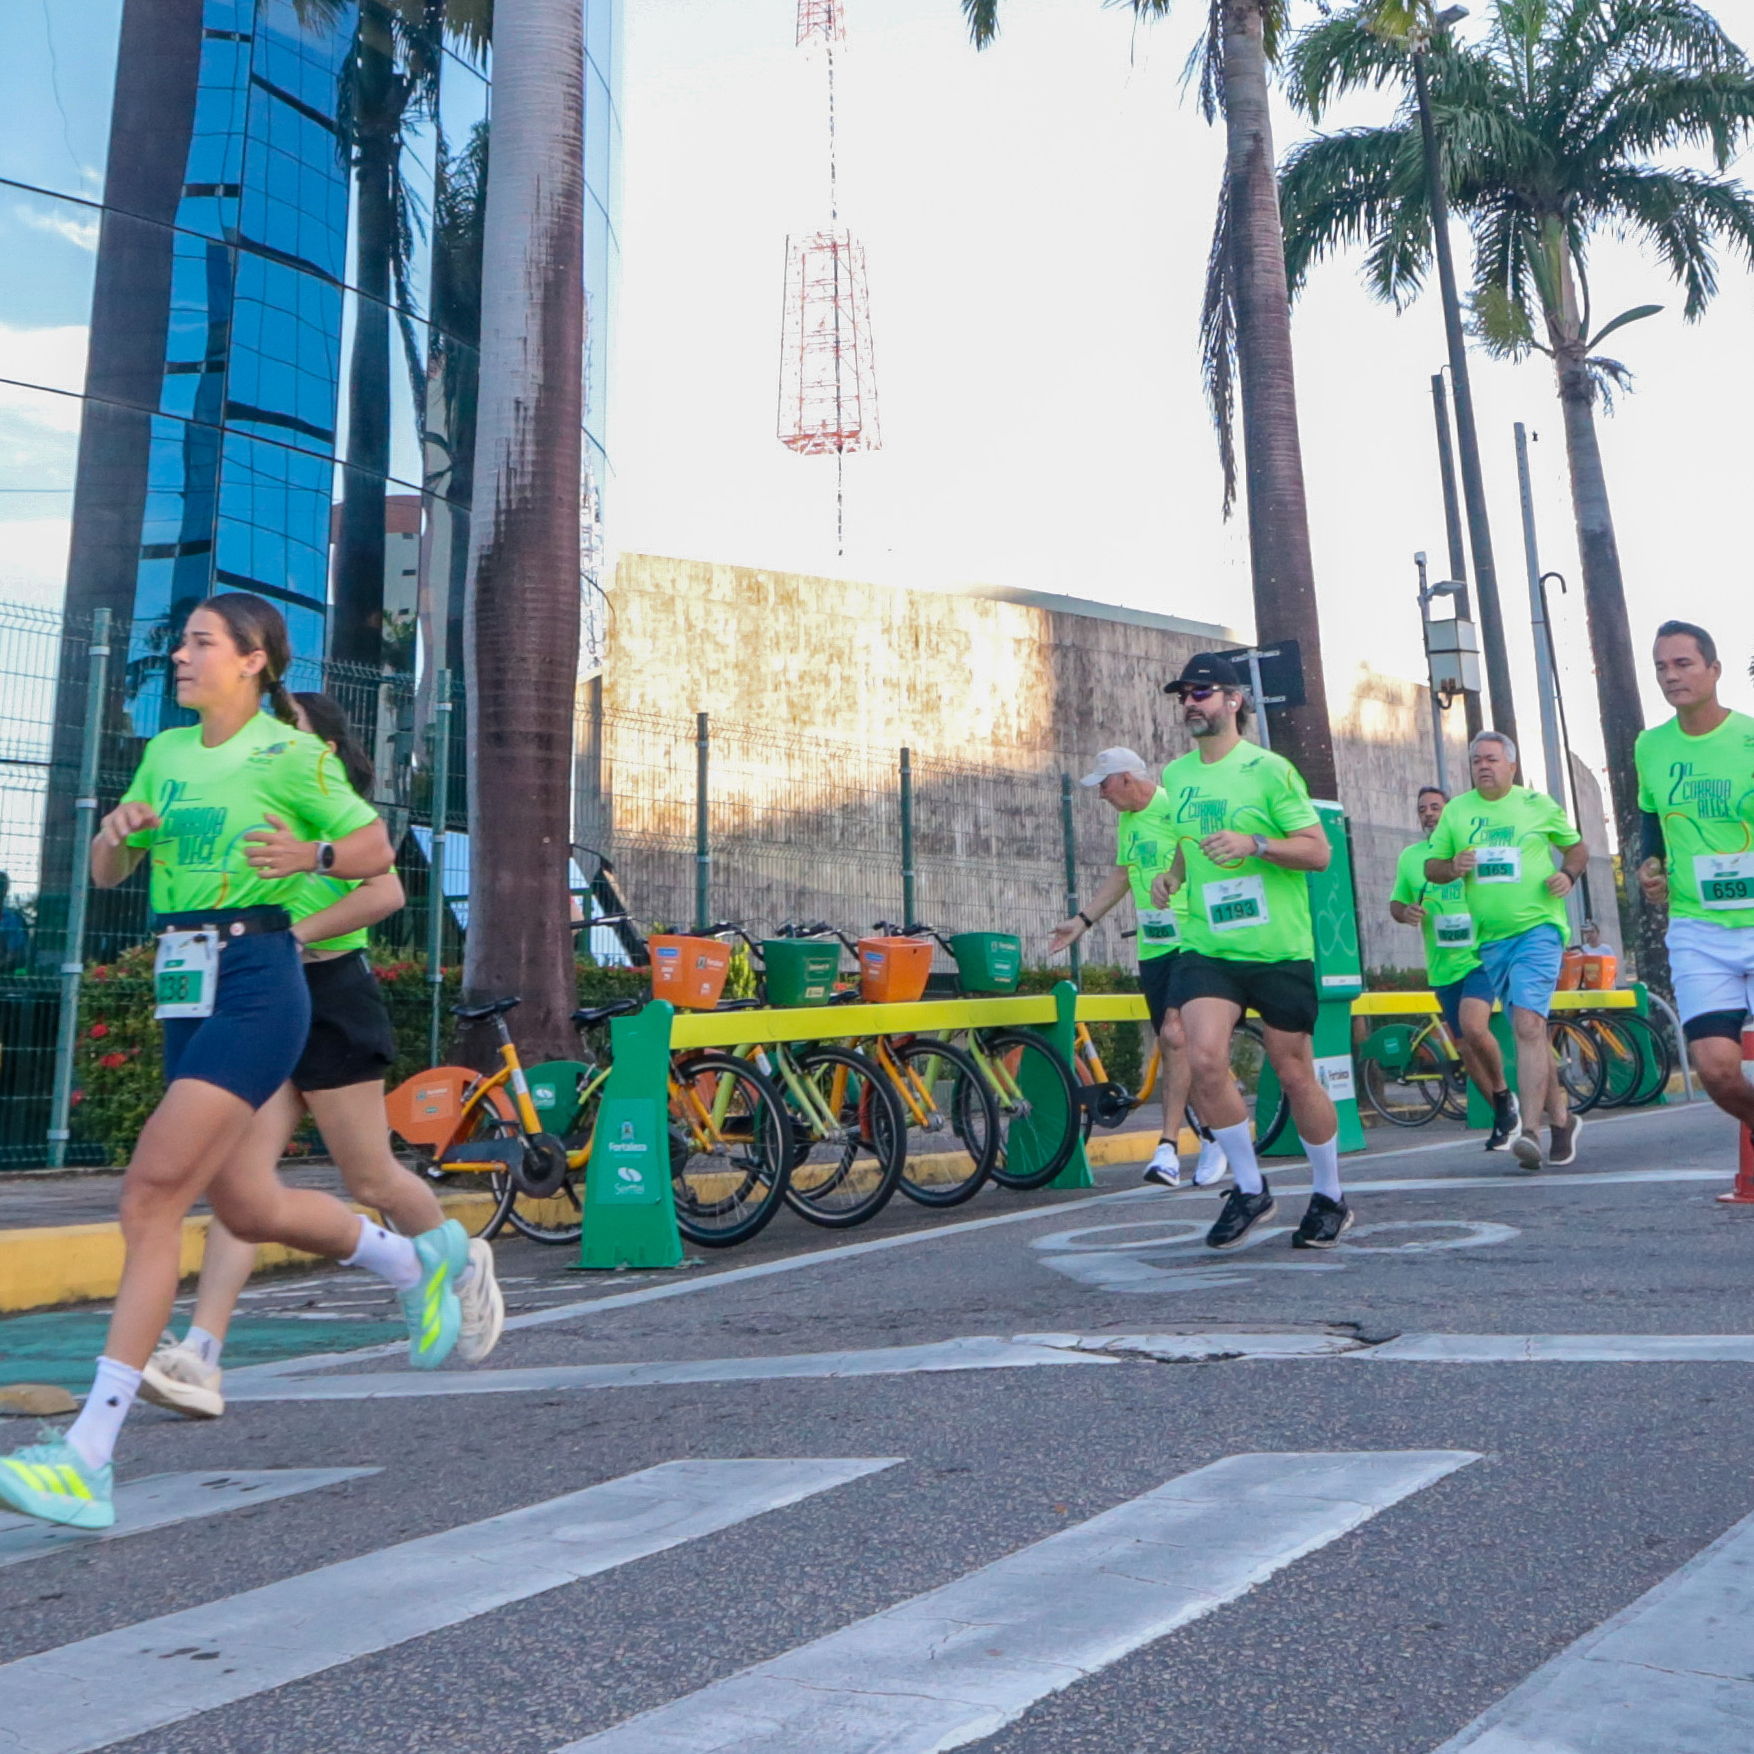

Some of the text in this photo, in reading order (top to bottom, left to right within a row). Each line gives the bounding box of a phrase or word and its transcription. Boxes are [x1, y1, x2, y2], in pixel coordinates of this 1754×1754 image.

[1683, 779, 1732, 801] CORRIDA
[1698, 796, 1730, 819] ALECE
[1484, 862, 1507, 876] 165
[1713, 880, 1747, 899] 659
[1215, 902, 1257, 921] 1193
